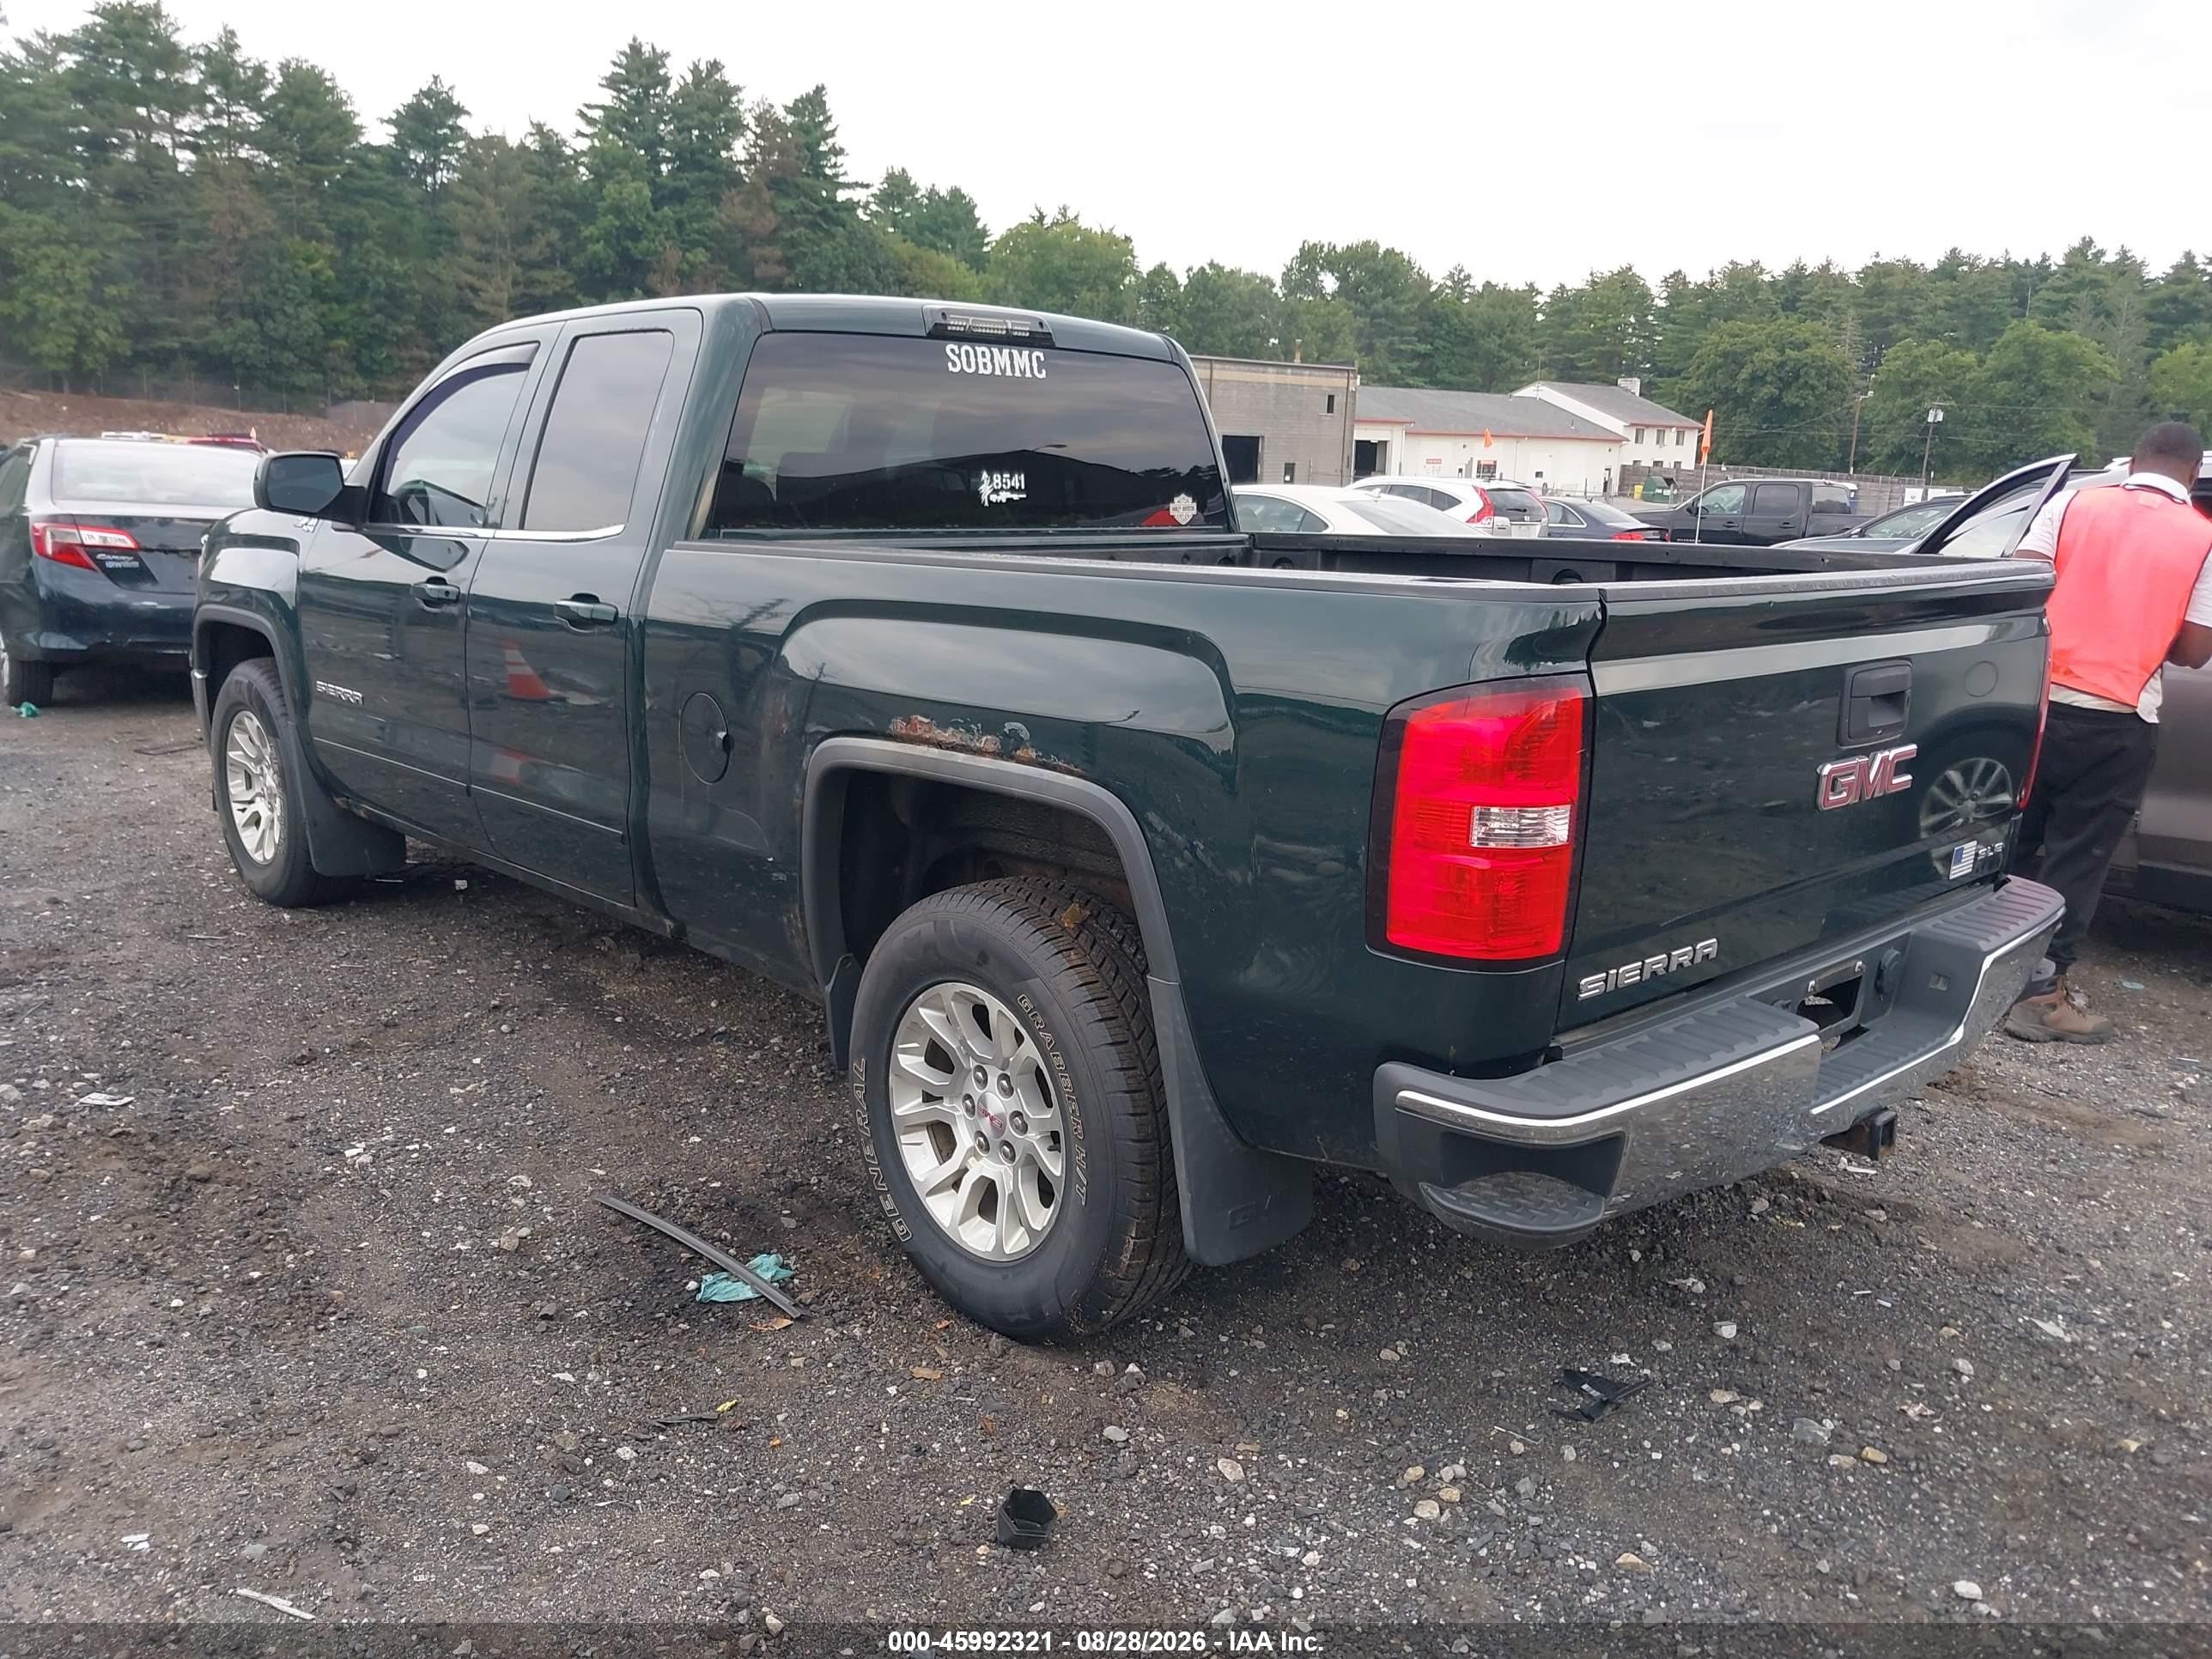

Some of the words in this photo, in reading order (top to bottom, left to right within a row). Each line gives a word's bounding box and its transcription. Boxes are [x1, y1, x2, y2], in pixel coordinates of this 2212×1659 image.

[945, 343, 1047, 379] SOBMMC
[993, 473, 1025, 490] 8541
[315, 680, 363, 705] SIERRA
[1816, 744, 1917, 811] GMC
[1577, 938, 1718, 1001] SIERRA
[1017, 993, 1085, 1141] GRABBER
[853, 1057, 913, 1243] GENERAL
